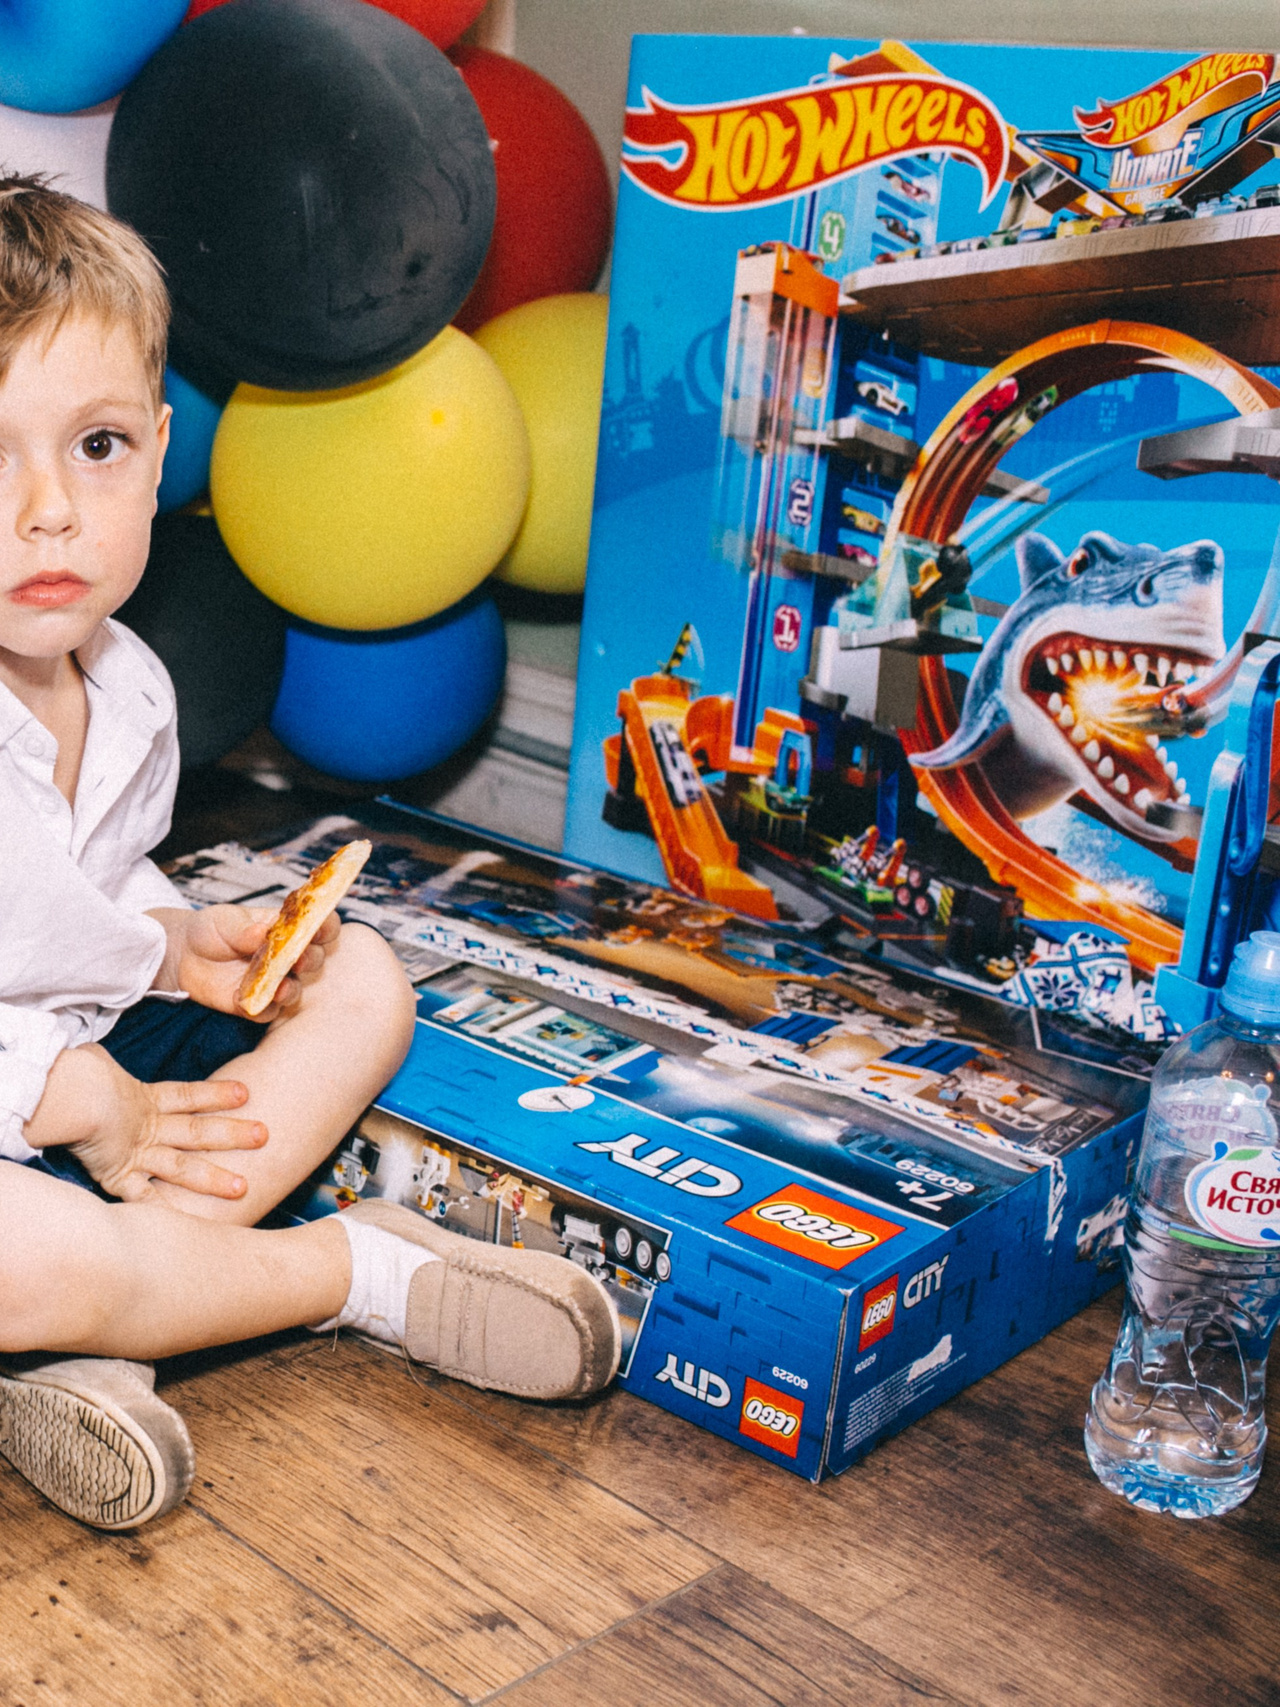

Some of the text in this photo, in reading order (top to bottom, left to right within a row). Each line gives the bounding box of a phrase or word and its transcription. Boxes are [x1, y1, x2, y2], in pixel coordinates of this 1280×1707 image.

[1109, 132, 1202, 188] ULTIMATE
[823, 223, 840, 254] 4
[791, 488, 812, 520] 2
[779, 611, 796, 643] 1
[574, 1133, 742, 1197] CITY
[895, 1160, 975, 1194] 60229
[895, 1179, 954, 1212] 7+
[1206, 1187, 1280, 1216] Исто
[757, 1203, 876, 1248] LEGO
[862, 1253, 950, 1333] LEGO CITY
[655, 1353, 731, 1408] CITY
[771, 1366, 809, 1390] 60229
[746, 1398, 797, 1436] LEGO
